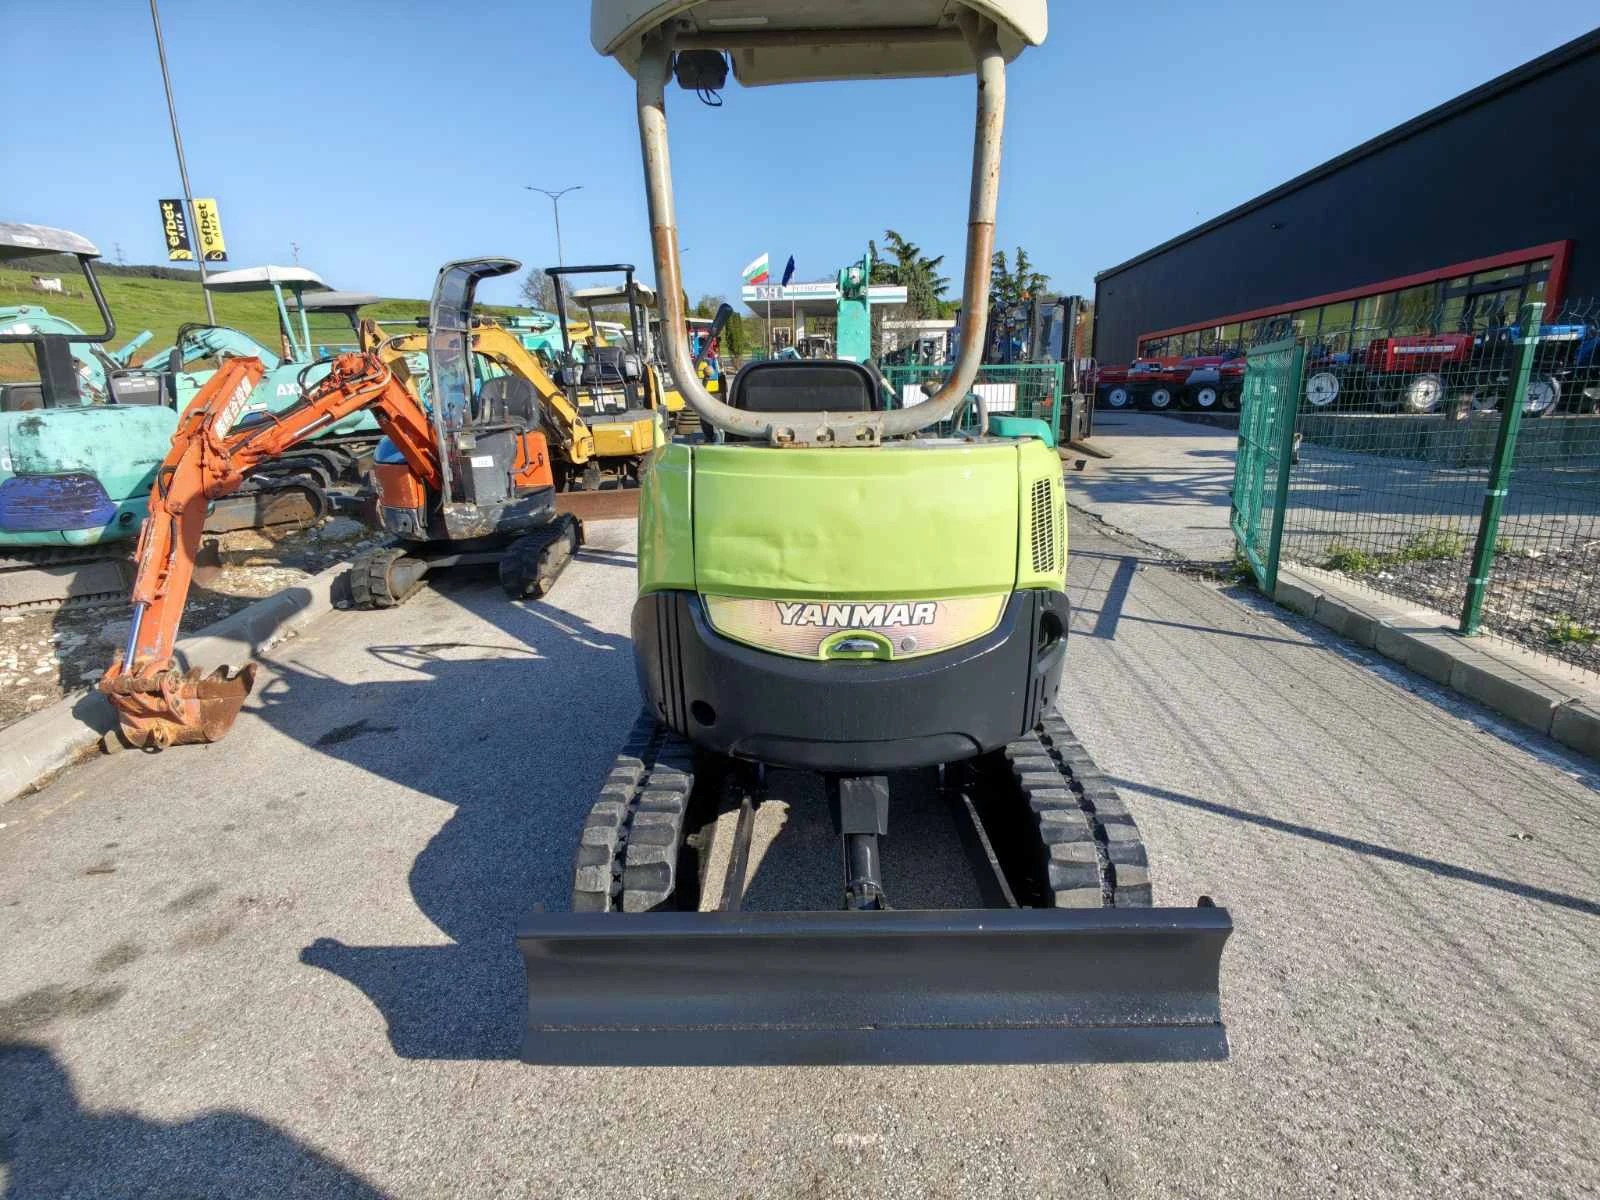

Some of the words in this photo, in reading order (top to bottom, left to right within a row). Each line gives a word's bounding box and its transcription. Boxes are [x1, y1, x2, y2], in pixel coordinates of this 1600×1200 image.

[162, 203, 180, 247] efbet
[197, 203, 213, 245] efbet
[775, 601, 937, 628] YANMAR
